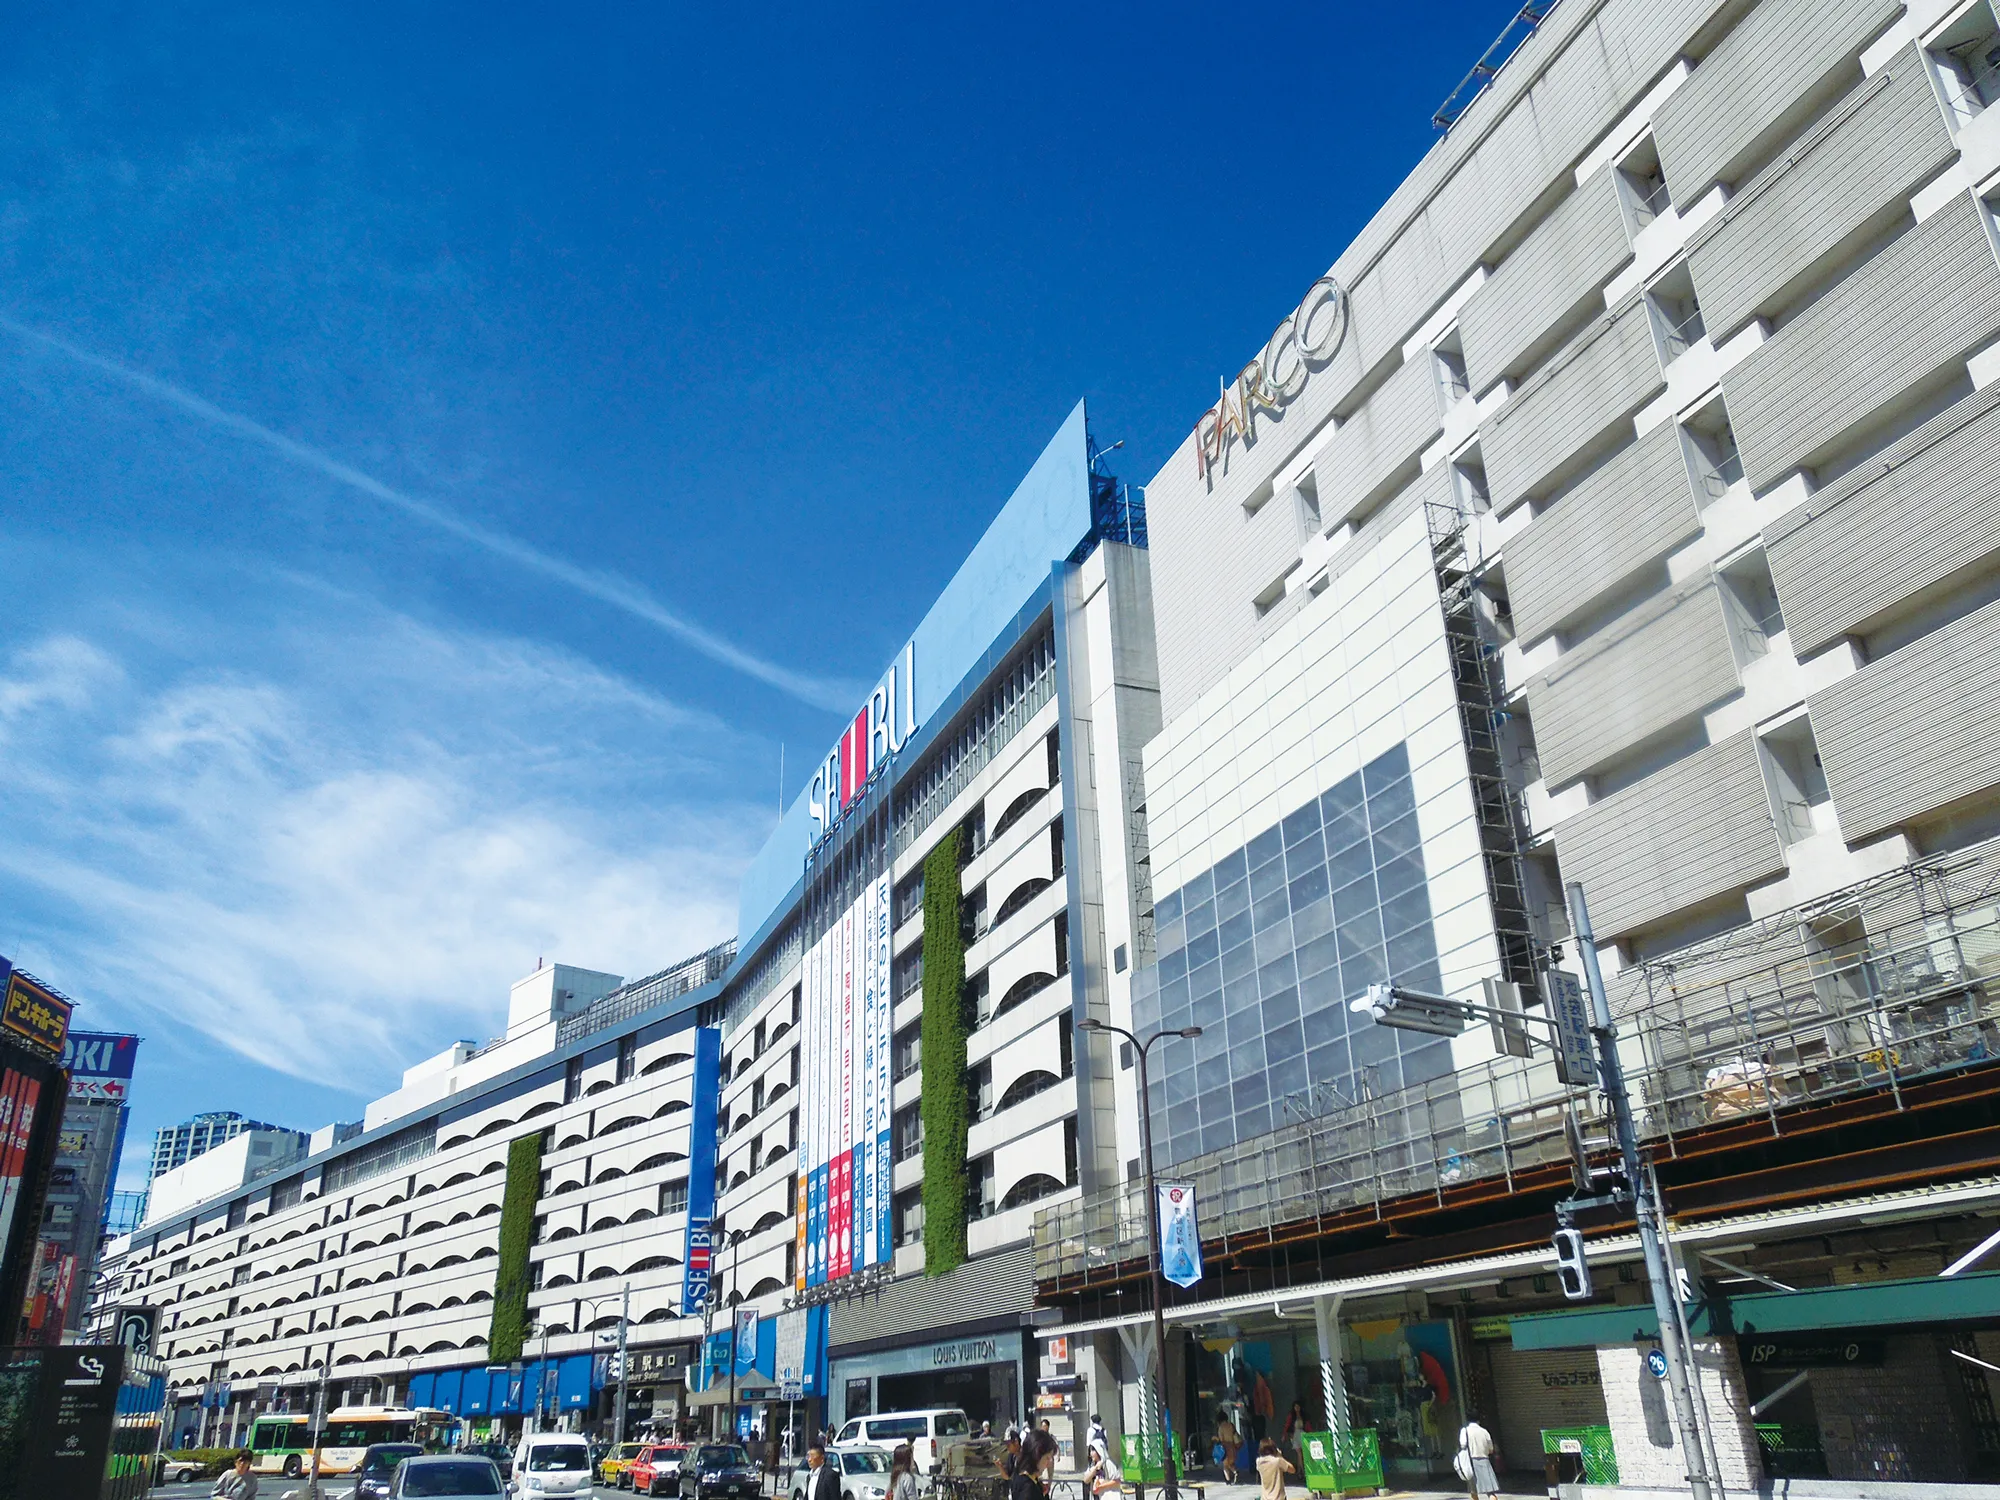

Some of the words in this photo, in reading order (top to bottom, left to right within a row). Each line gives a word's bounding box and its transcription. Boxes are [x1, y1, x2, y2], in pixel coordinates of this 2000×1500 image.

[1194, 276, 1343, 480] PARCO
[1555, 977, 1570, 1030] Ikebukuro
[1564, 979, 1593, 1074] 池袋駅東口
[688, 1216, 711, 1298] SEIBU
[933, 1346, 957, 1365] LOUIS
[959, 1339, 996, 1362] VUITTON
[1649, 1355, 1665, 1373] 26
[1751, 1344, 1777, 1363] ISP
